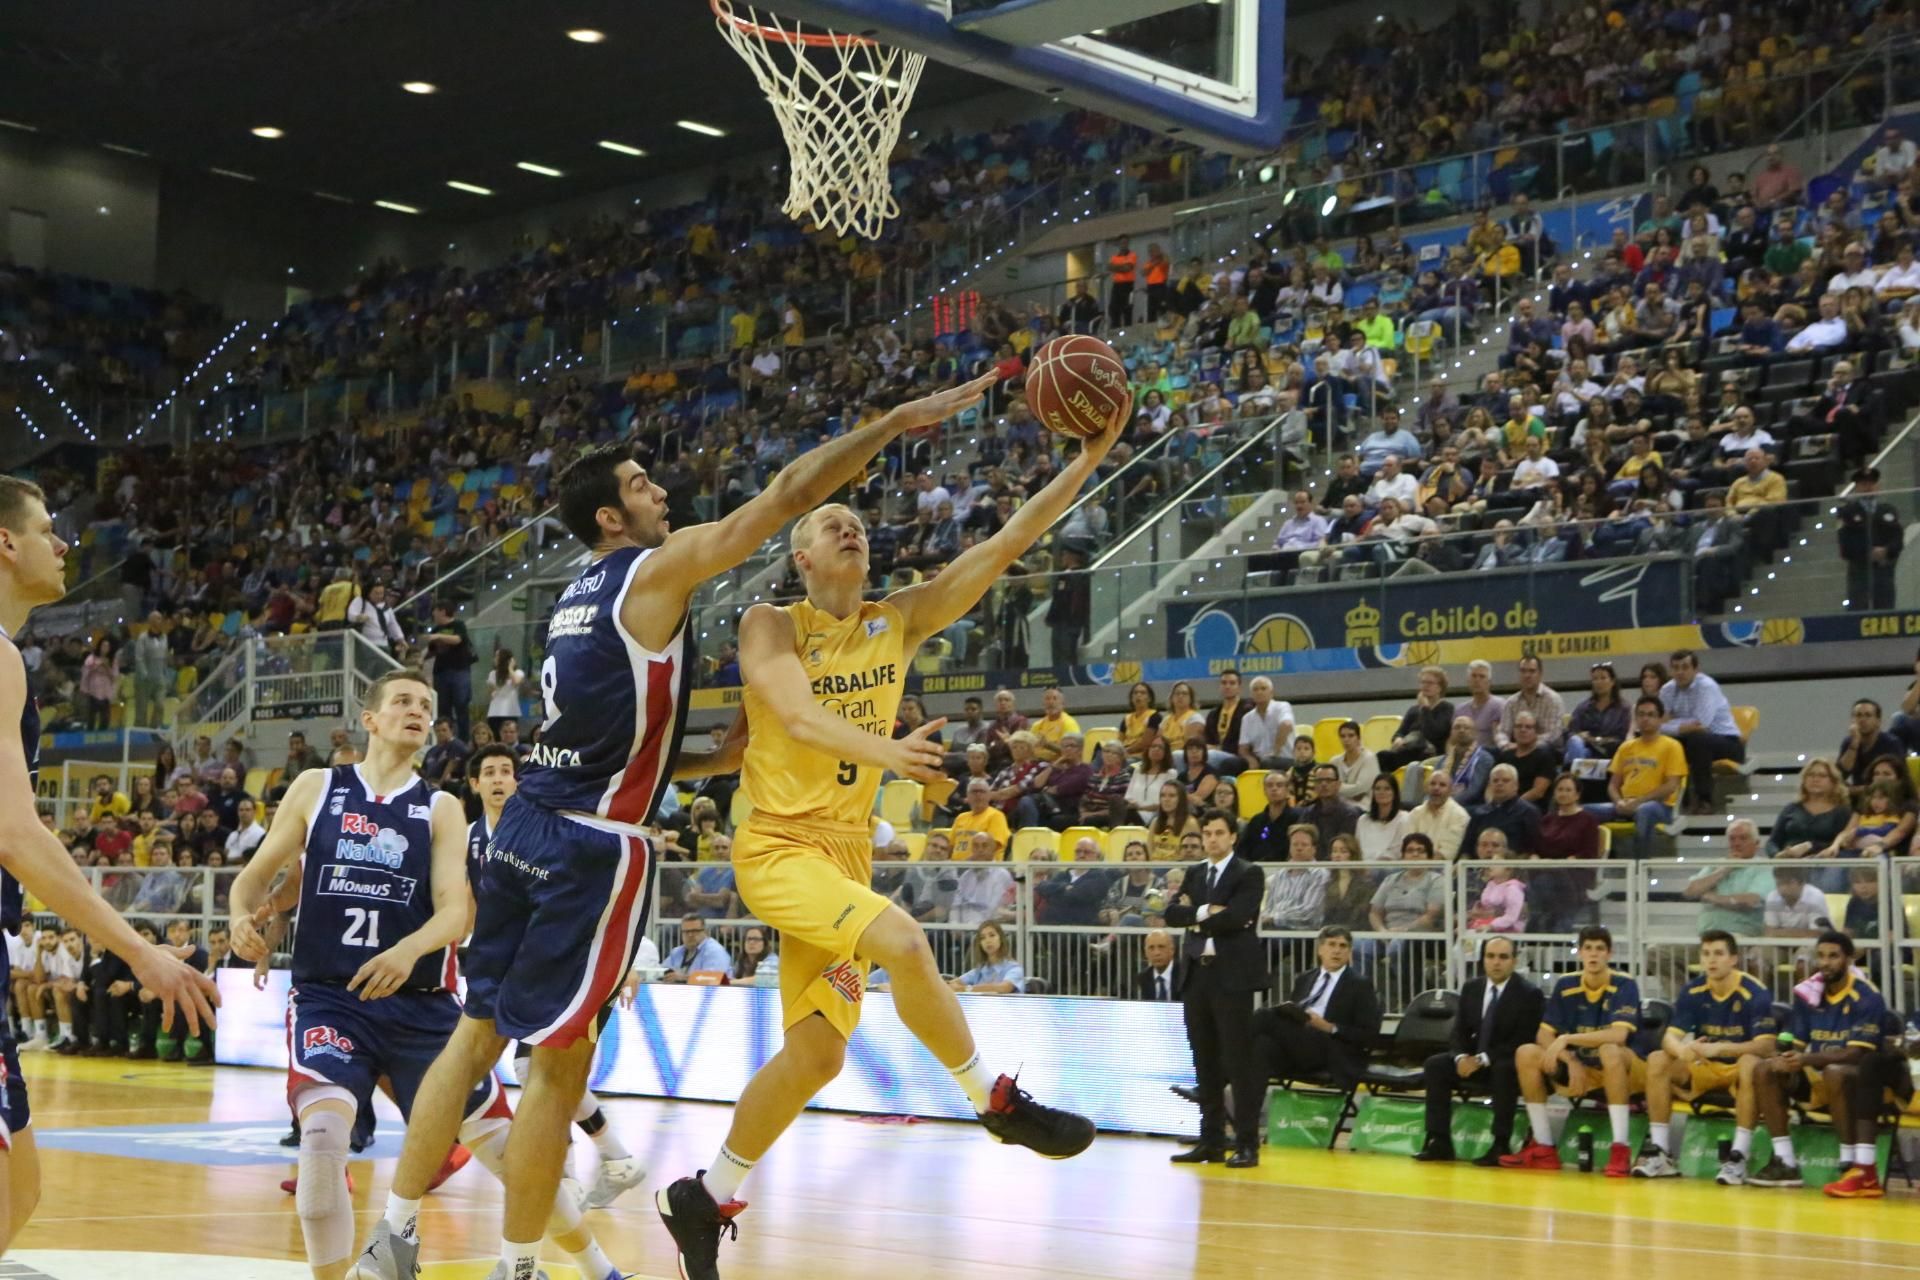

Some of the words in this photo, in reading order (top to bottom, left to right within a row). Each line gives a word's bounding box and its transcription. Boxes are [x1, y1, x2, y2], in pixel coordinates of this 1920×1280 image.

[1067, 390, 1105, 430] SPALD
[1400, 605, 1498, 637] Cabildo
[1504, 602, 1538, 629] de
[1521, 637, 1553, 655] GRAN
[1558, 635, 1611, 653] CANARIA
[802, 663, 896, 695] ERBALIFE
[1209, 659, 1236, 676] GRAN
[1239, 656, 1283, 673] CANARIA
[922, 677, 946, 692] GRAN
[948, 674, 986, 691] CANARIA
[526, 742, 582, 769] ANCA
[341, 812, 379, 837] Rio
[336, 839, 404, 869] Natura
[341, 907, 380, 948] 21
[303, 1025, 354, 1053] Rio
